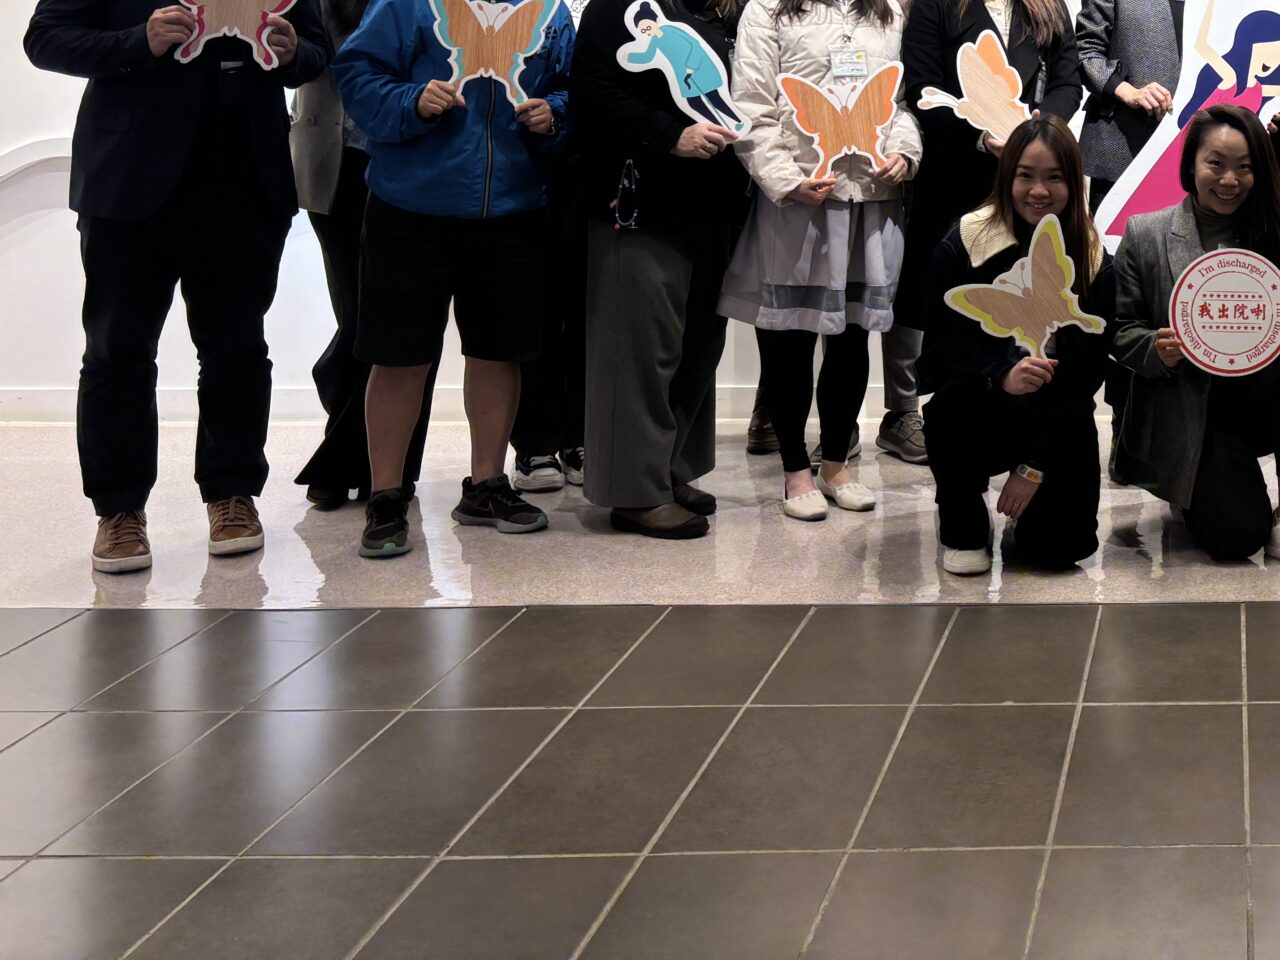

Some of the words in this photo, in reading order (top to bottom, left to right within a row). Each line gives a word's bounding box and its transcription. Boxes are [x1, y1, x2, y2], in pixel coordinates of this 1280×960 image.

[1198, 265, 1214, 277] I'm
[1217, 258, 1267, 279] discharged
[1180, 301, 1202, 350] discharged
[1203, 350, 1218, 364] I'm
